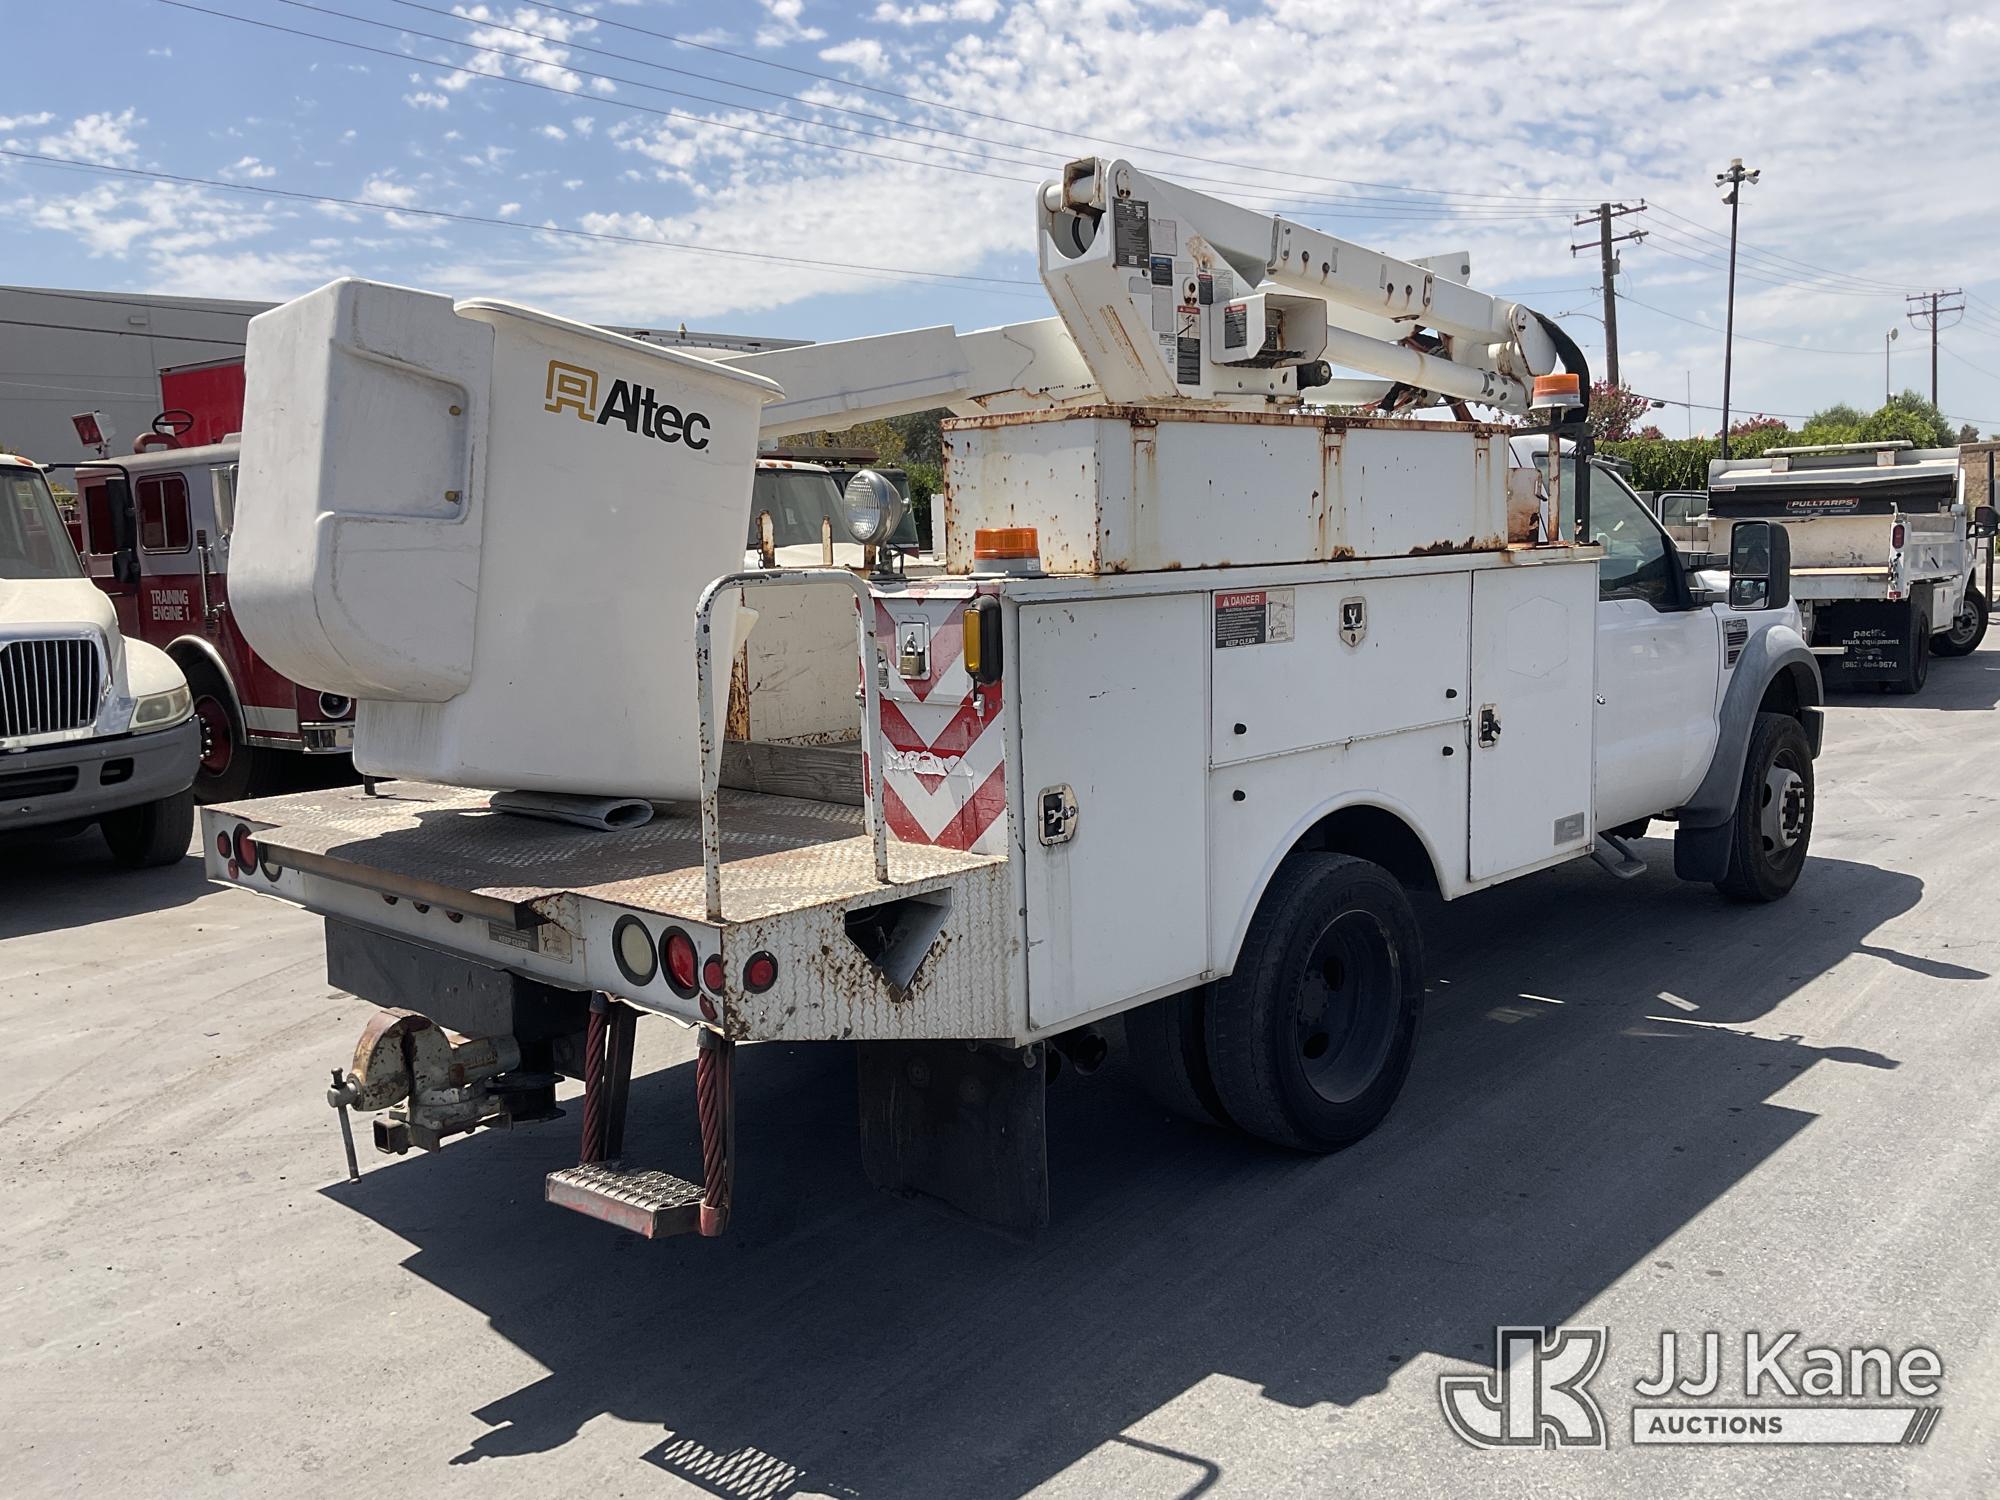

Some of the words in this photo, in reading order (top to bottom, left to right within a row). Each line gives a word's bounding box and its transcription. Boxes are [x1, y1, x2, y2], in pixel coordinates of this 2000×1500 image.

[597, 379, 711, 450] Altec
[1791, 499, 1854, 507] PULLTARPS
[150, 589, 189, 605] TRAINING
[1231, 594, 1260, 606] DANGER
[152, 606, 184, 621] ENGINE
[185, 606, 190, 621] 1
[1853, 629, 1886, 638] pacific
[1226, 639, 1239, 647] KEEP
[1239, 637, 1256, 645] CLEAR
[498, 935, 511, 944] KEEP
[512, 939, 529, 949] CLEAR
